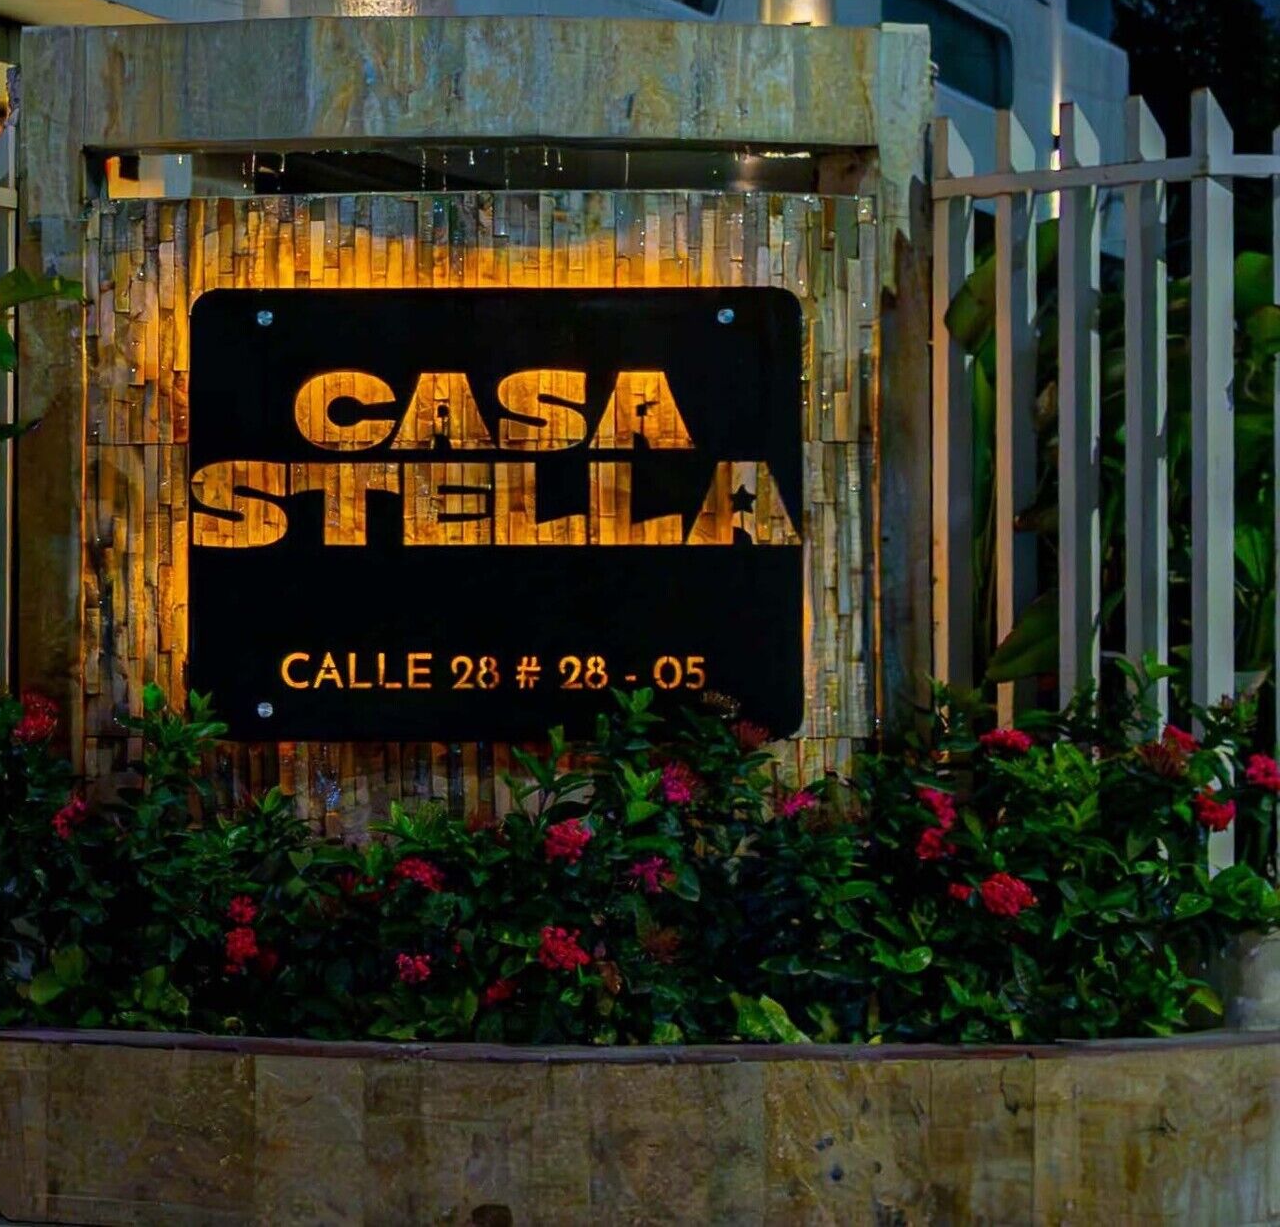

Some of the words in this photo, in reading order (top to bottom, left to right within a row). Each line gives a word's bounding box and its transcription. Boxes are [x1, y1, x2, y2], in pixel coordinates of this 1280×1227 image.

[293, 368, 695, 451] CASA
[191, 460, 802, 547] STELLA
[280, 651, 432, 689] CALLE
[450, 654, 500, 689] 28
[515, 654, 542, 689] #
[558, 654, 608, 689] 28
[653, 654, 705, 690] 05
